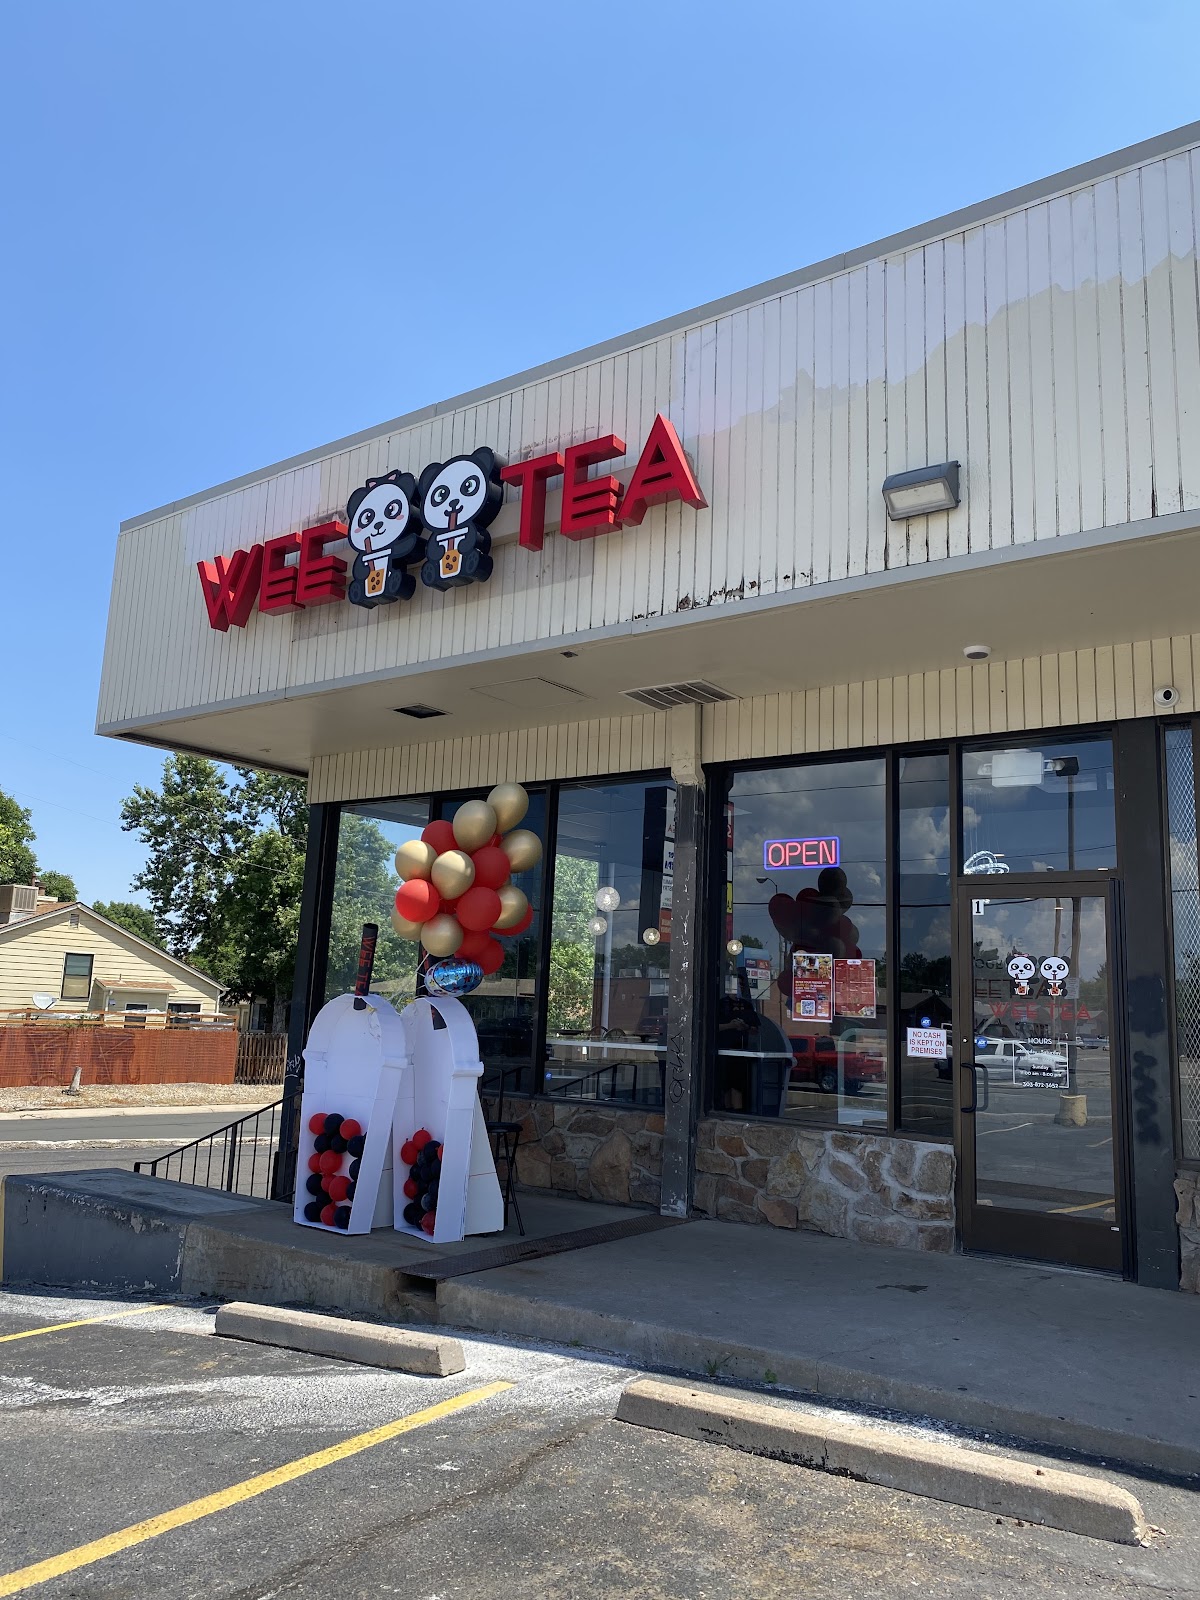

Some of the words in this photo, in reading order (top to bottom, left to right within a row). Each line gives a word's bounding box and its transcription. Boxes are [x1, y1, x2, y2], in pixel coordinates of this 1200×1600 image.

[197, 520, 348, 632] WEE
[501, 413, 708, 552] TEA
[768, 840, 836, 867] OPEN
[975, 900, 982, 914] 1
[989, 1001, 1038, 1019] WEE
[1045, 1002, 1092, 1021] TEA
[911, 1046, 943, 1055] PREMISES
